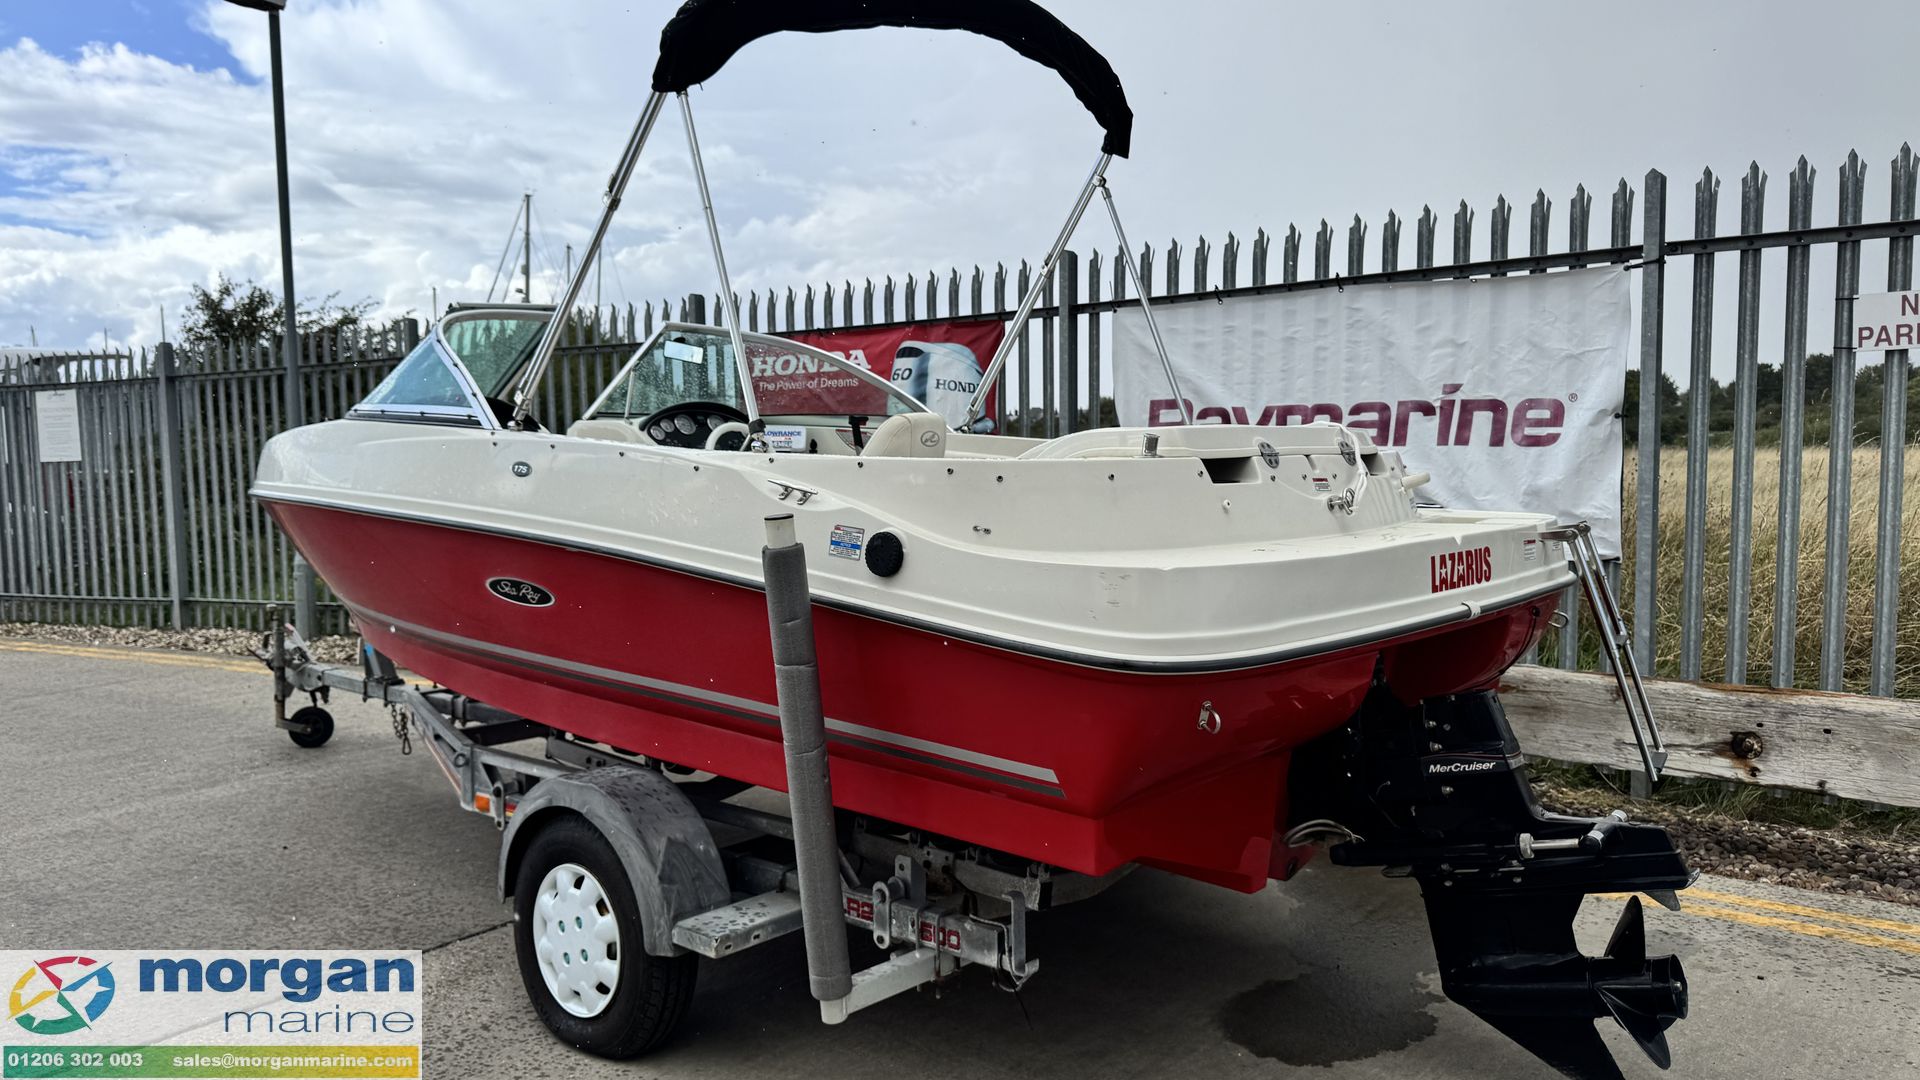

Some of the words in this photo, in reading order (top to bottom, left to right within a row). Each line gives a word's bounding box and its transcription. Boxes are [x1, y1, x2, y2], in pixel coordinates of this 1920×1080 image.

[1858, 322, 1920, 348] PAR
[752, 349, 871, 377] HONDA
[892, 367, 912, 381] 60
[760, 381, 775, 391] The
[776, 380, 806, 390] Power
[807, 379, 817, 389] of
[820, 378, 859, 388] Dreams
[935, 378, 980, 394] HOND
[514, 465, 528, 473] 175
[1430, 545, 1492, 594] LAZARUS
[497, 581, 518, 596] Sea
[519, 584, 541, 603] Ray
[1429, 761, 1496, 773] MerCruiser
